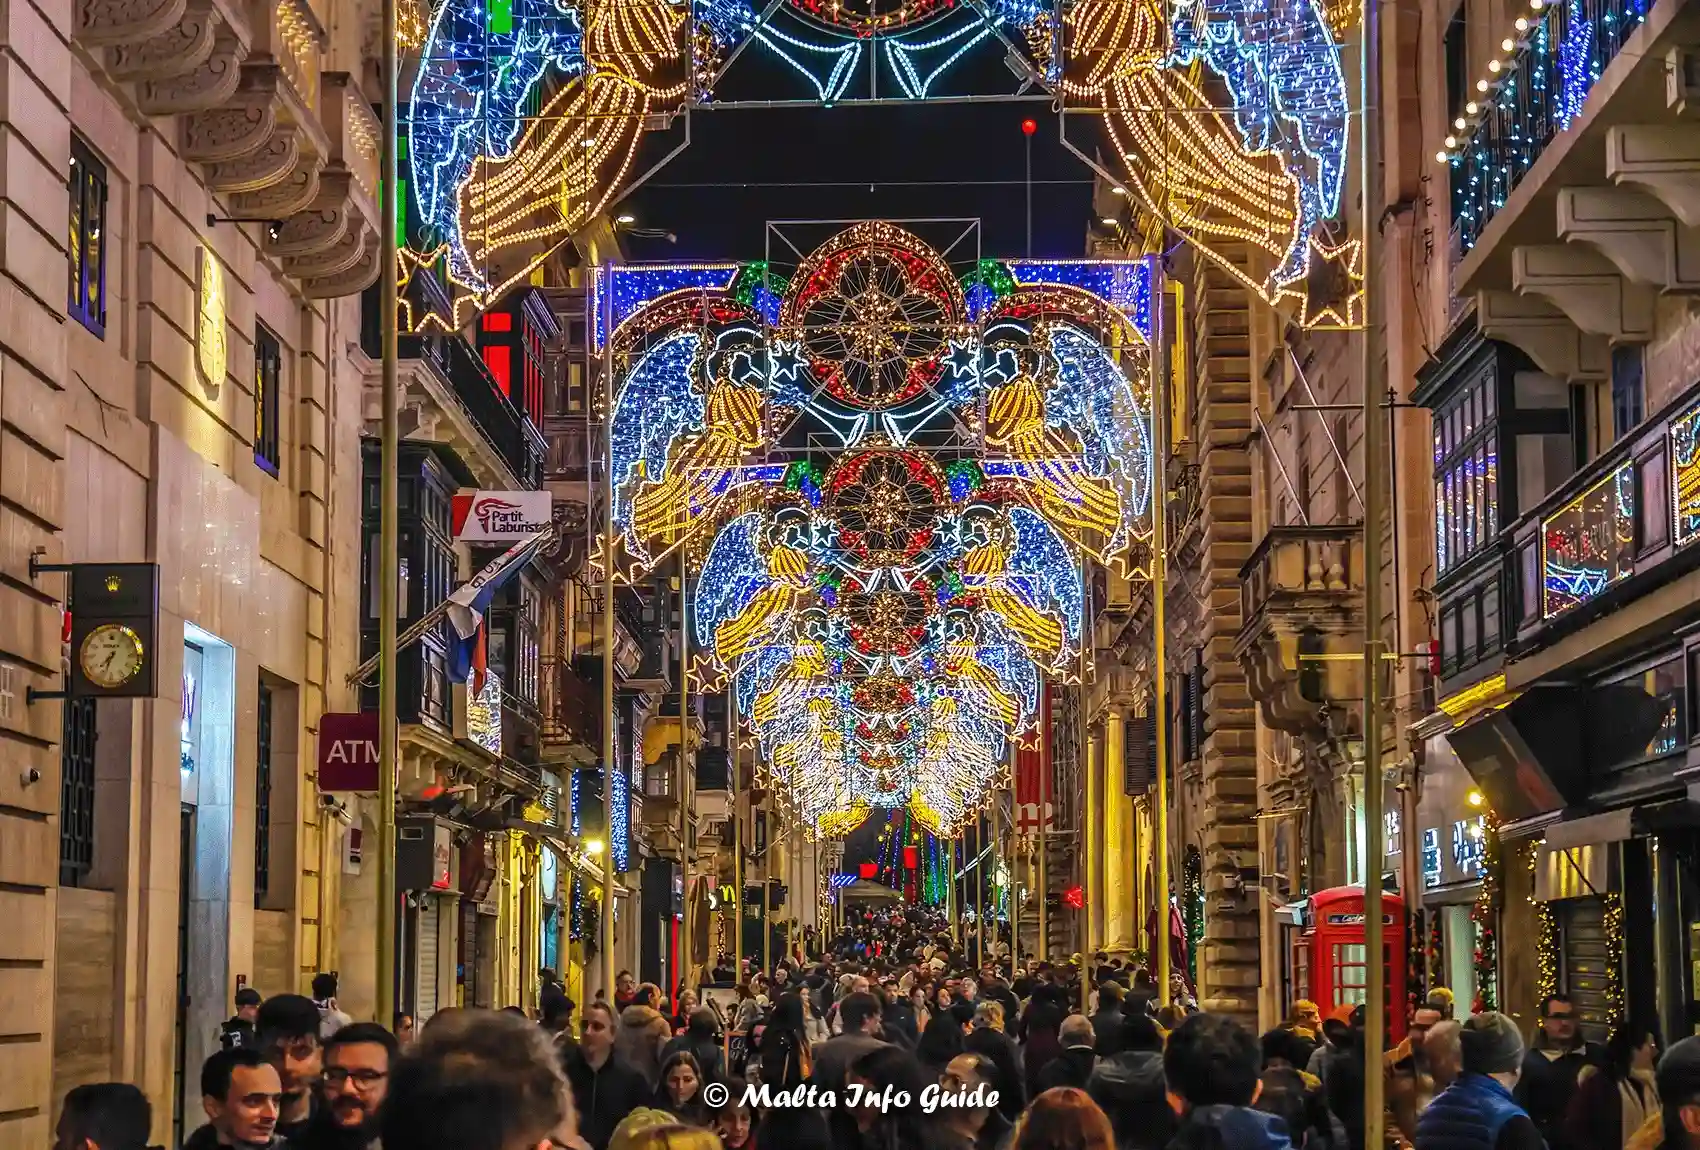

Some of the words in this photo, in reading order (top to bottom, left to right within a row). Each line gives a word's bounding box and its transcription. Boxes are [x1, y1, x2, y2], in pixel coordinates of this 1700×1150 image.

[492, 510, 524, 522] Partit
[492, 521, 541, 533] Laburist
[325, 739, 381, 764] ATM
